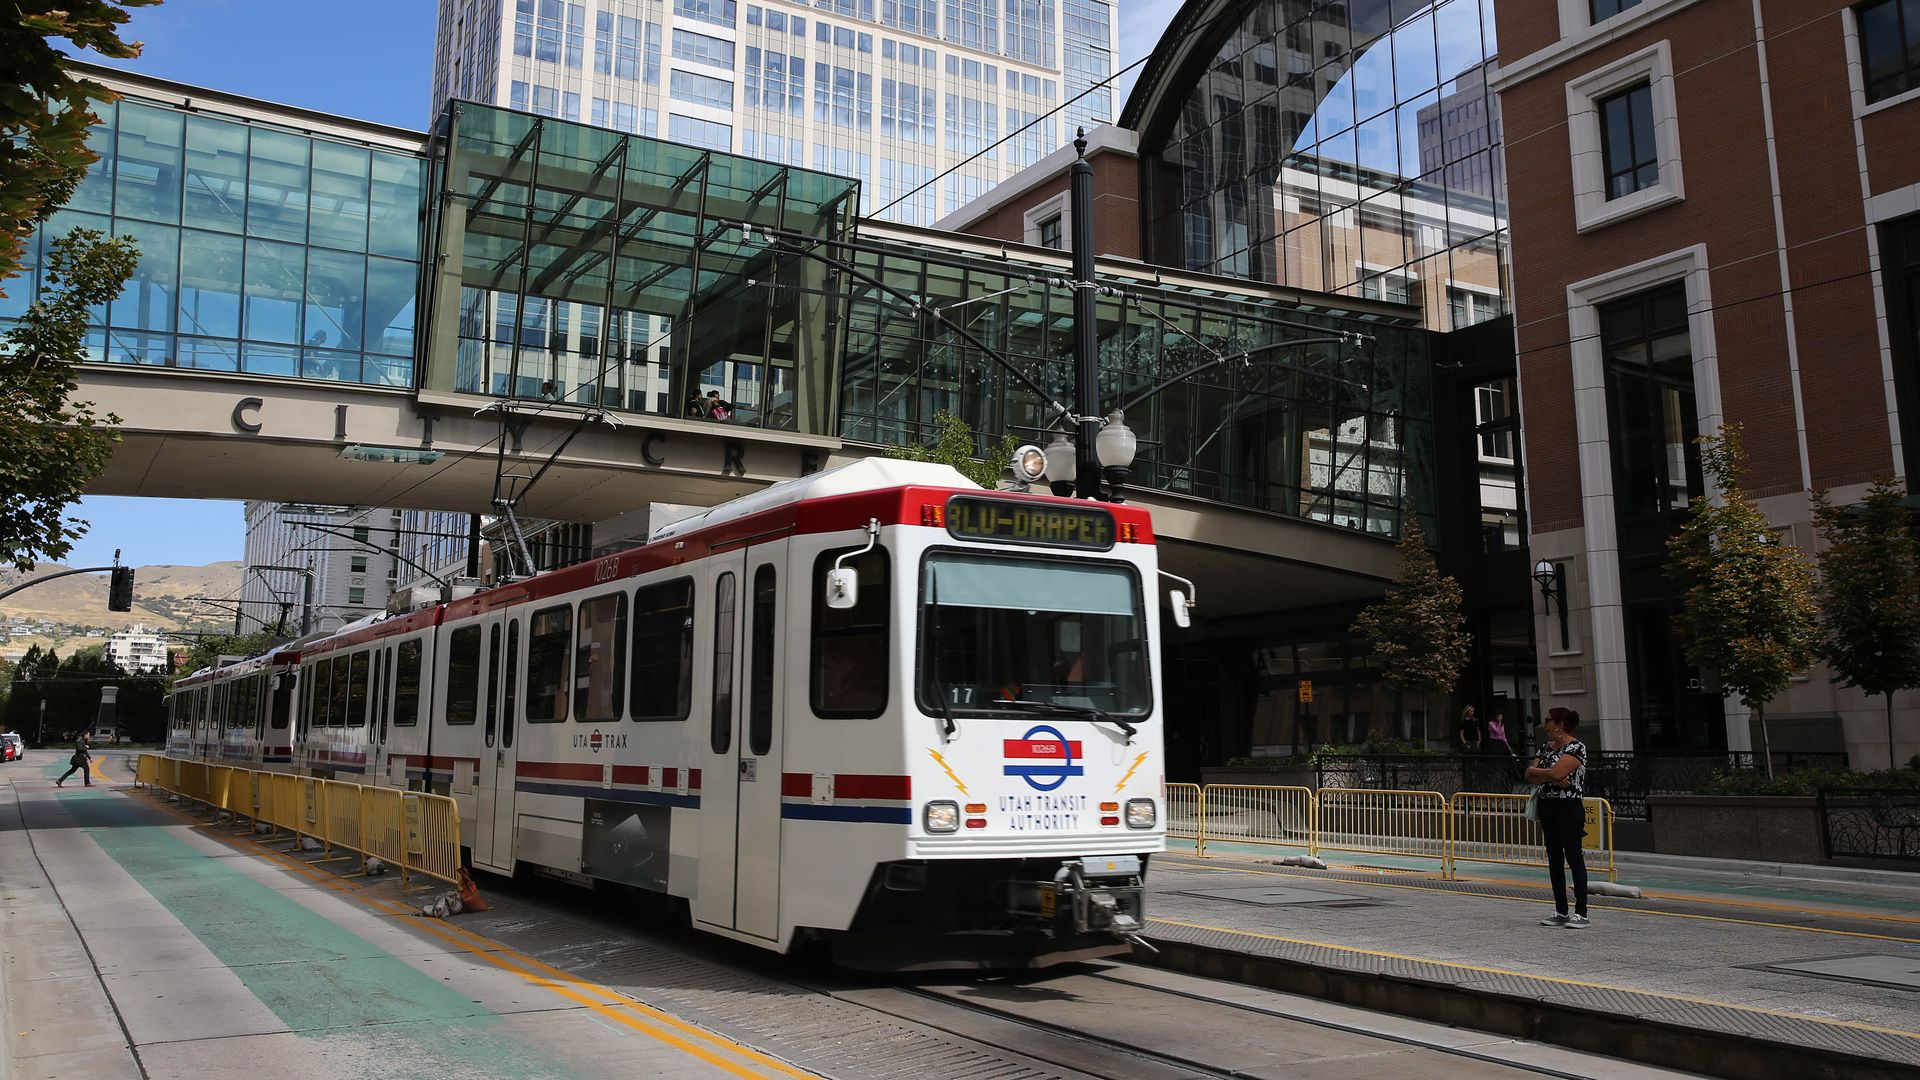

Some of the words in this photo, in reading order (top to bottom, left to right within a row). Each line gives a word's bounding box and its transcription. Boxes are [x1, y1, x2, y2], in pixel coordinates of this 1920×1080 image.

[232, 397, 529, 454] CITY
[594, 557, 620, 582] 1026B
[951, 687, 973, 704] 17
[573, 734, 588, 748] UTA
[605, 734, 627, 749] TRAX
[999, 795, 1032, 811] UTAH
[1036, 795, 1086, 811] TRANSIT
[1009, 814, 1079, 830] AUTHORITY
